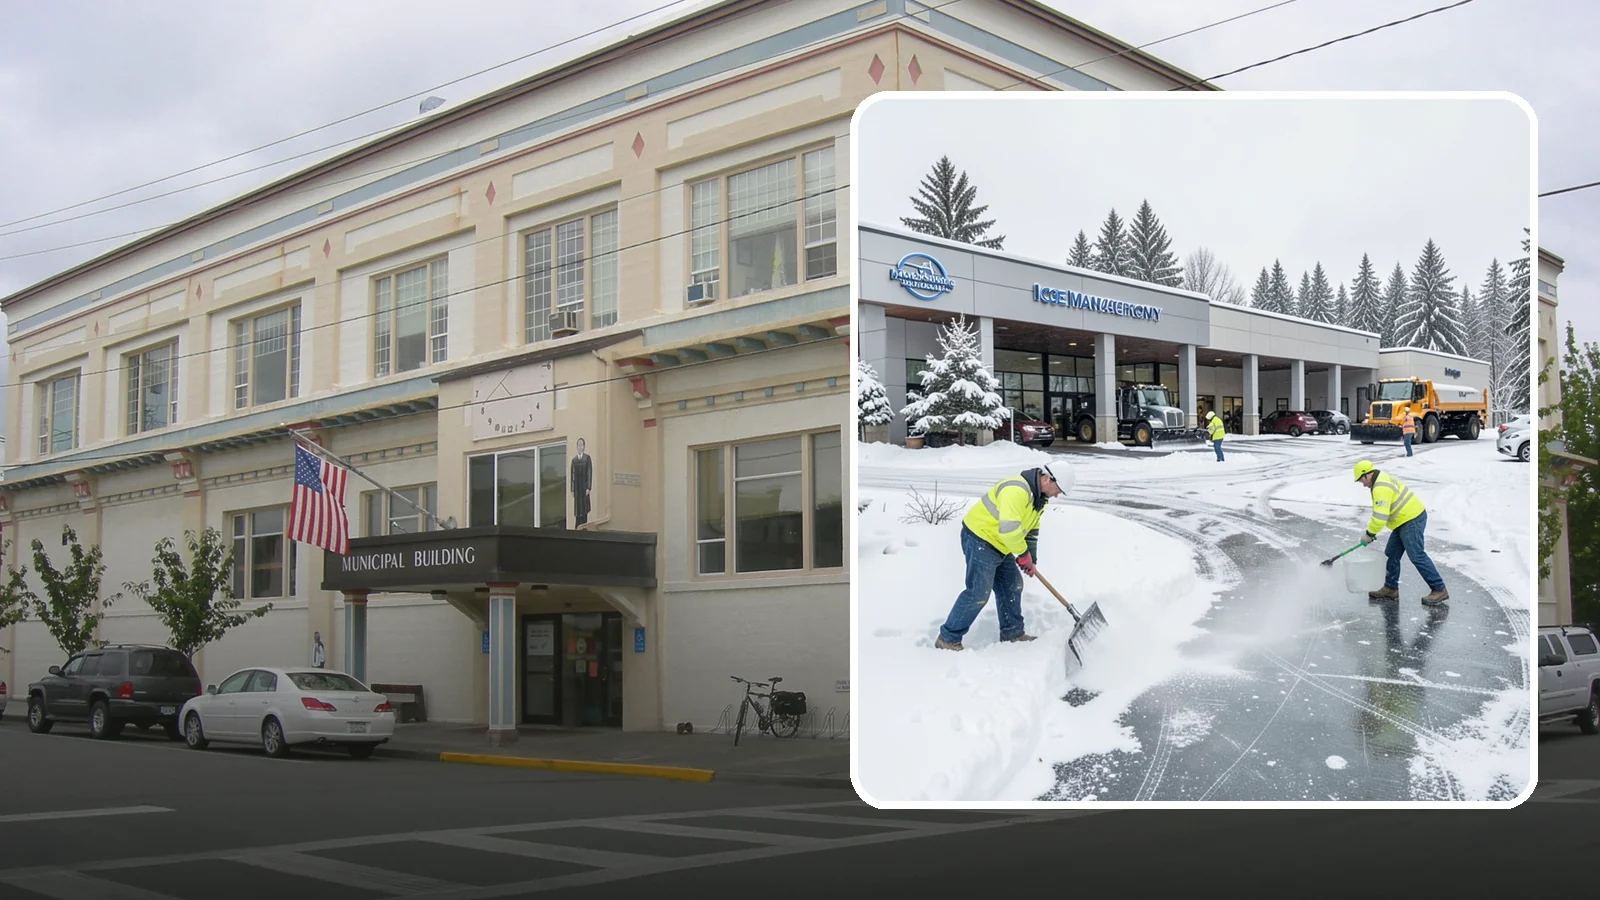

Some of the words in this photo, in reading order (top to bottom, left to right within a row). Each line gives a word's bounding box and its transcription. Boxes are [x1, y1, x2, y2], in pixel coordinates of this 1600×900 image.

[480, 406, 485, 415] 8
[487, 417, 493, 426] 9
[528, 413, 533, 422] 3
[494, 423, 500, 432] 10
[521, 420, 526, 428] 2
[507, 425, 514, 433] 12
[342, 552, 405, 572] MUNICIPAL
[414, 546, 475, 567] BUILDING
